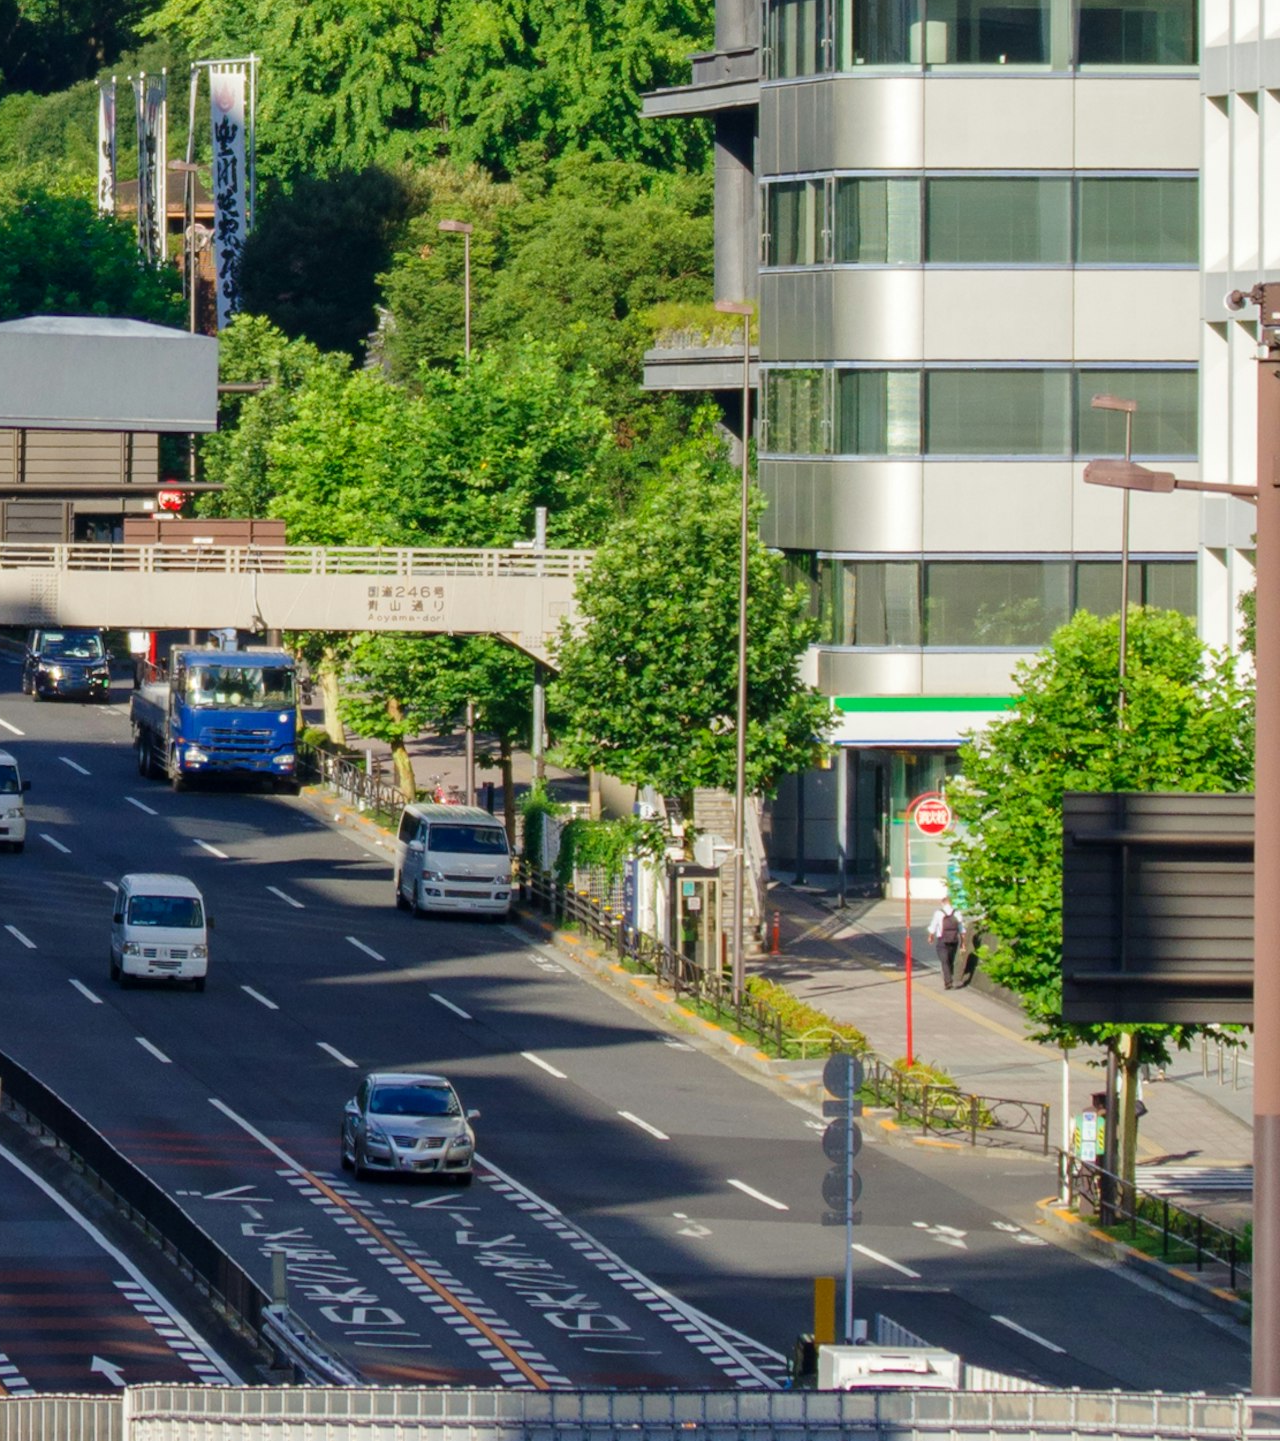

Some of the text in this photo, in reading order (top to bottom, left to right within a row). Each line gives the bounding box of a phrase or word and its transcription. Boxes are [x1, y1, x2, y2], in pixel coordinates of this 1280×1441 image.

[367, 585, 445, 599] 国道246号
[367, 600, 445, 612] 青山通り
[367, 613, 446, 624] Aoyama-dori
